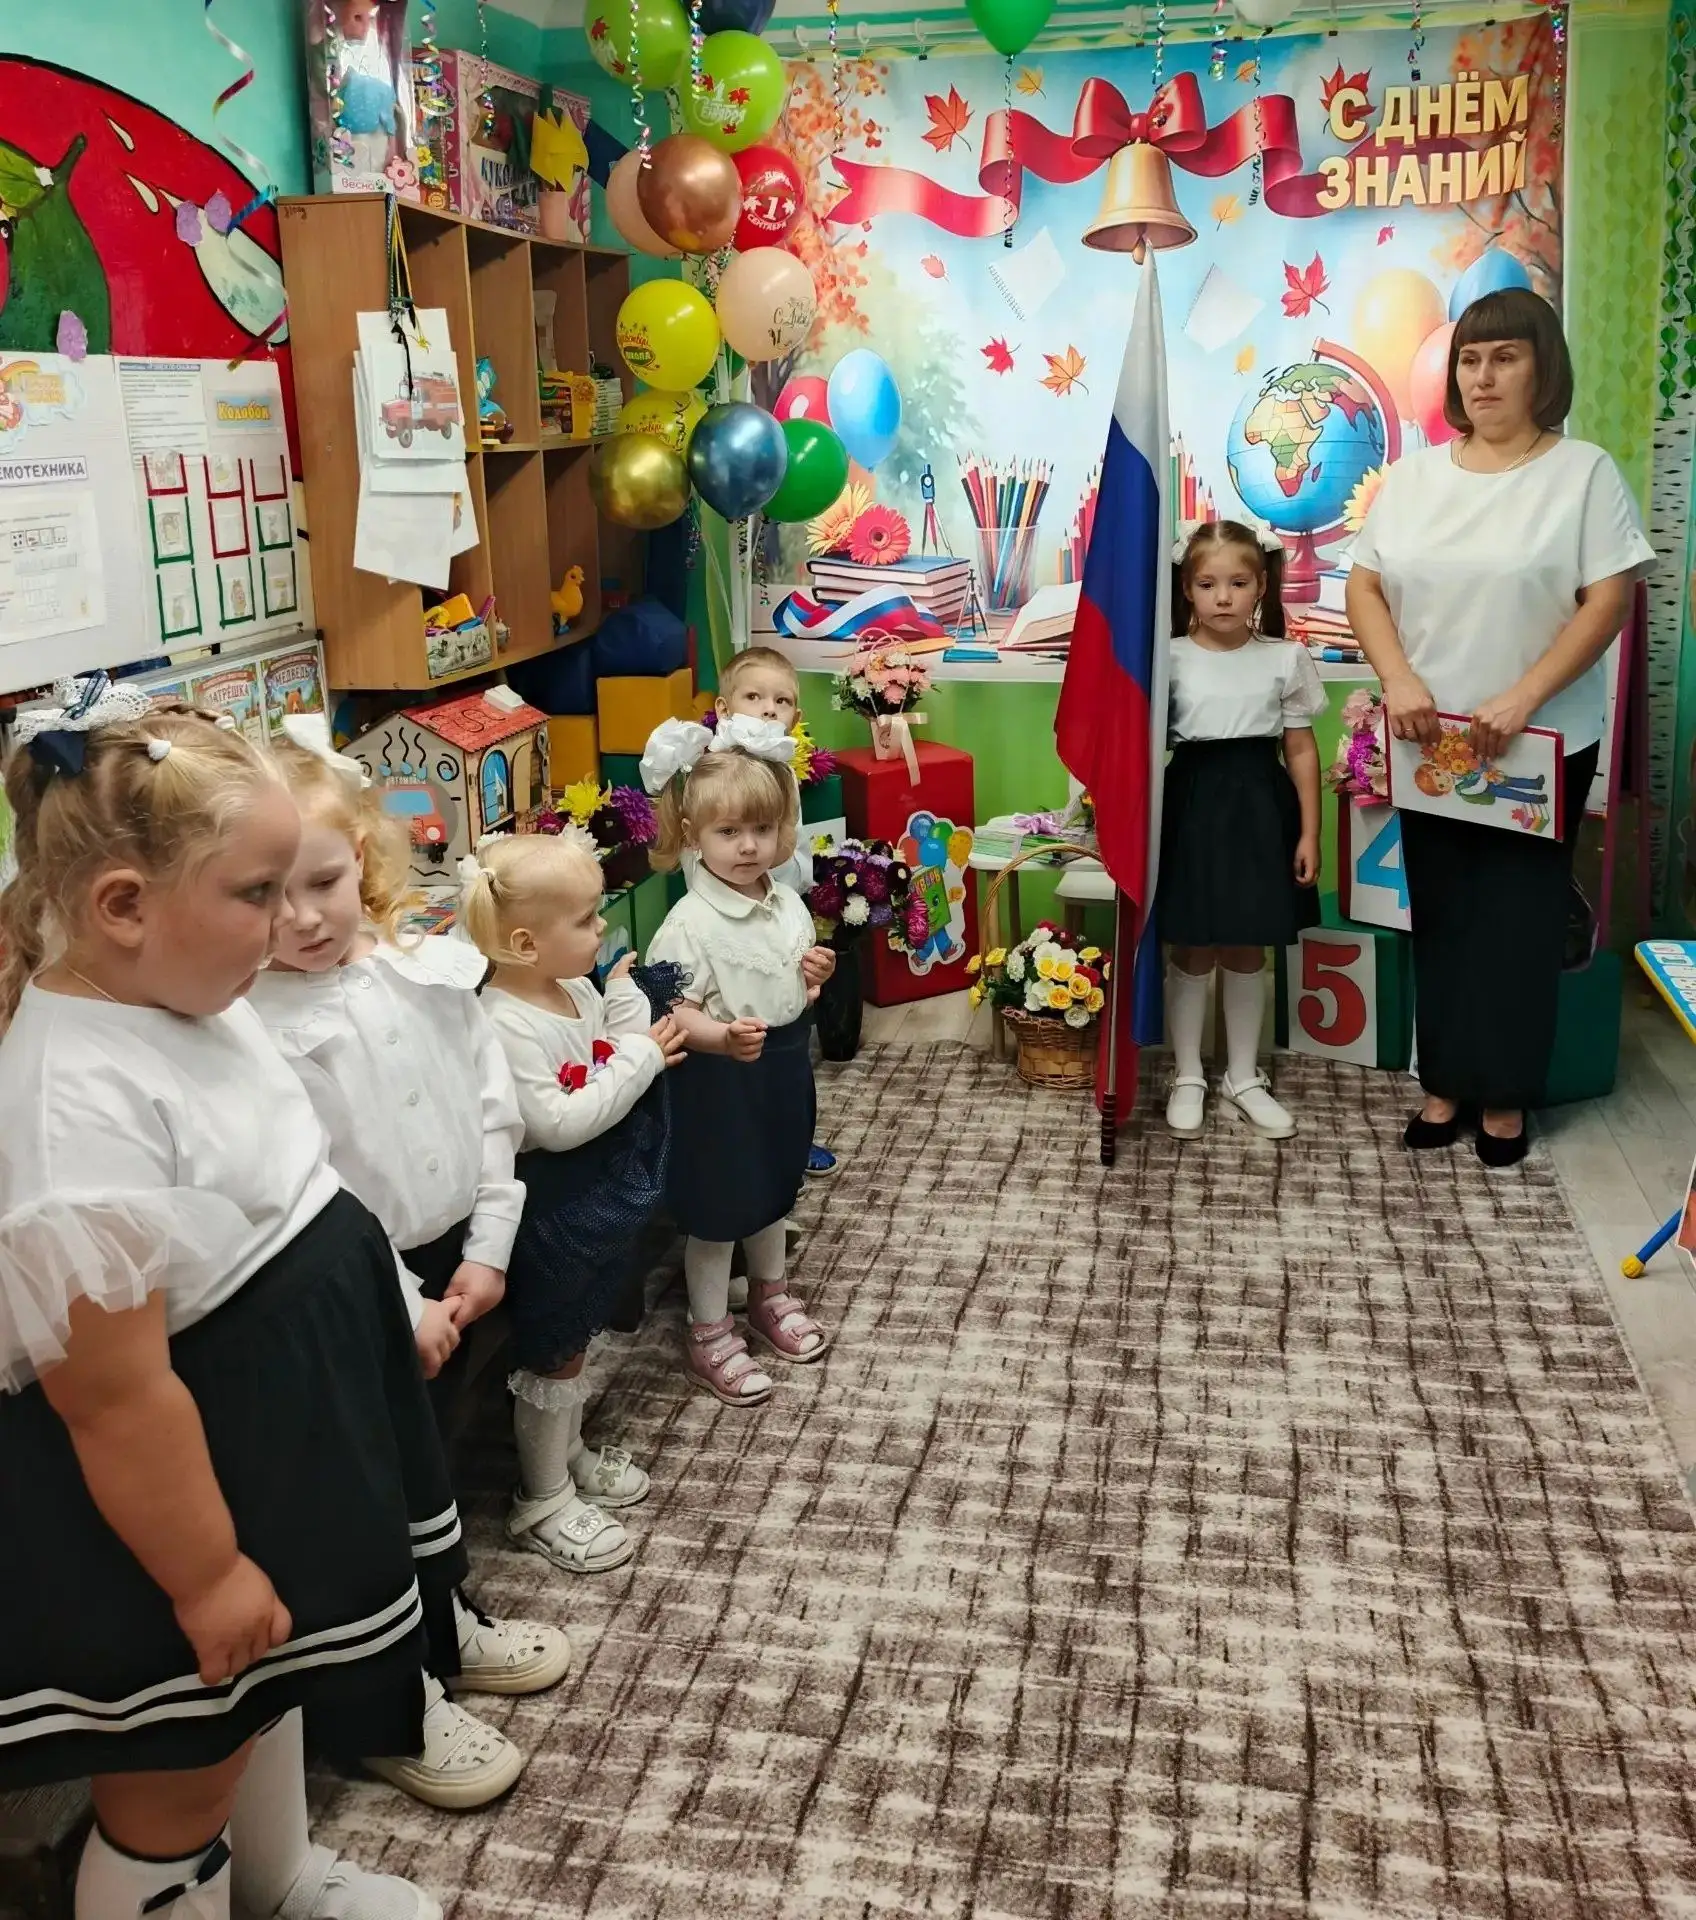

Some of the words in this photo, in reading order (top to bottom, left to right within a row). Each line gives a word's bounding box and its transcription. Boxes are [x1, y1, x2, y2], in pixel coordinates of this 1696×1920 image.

[1329, 87, 1368, 141] С
[1375, 71, 1529, 148] ДНЁМ
[763, 196, 779, 221] 1
[1316, 129, 1528, 210] ЗНАНИЙ
[216, 400, 271, 421] Колобок
[1356, 808, 1411, 910] 4
[1298, 938, 1366, 1047] 5
